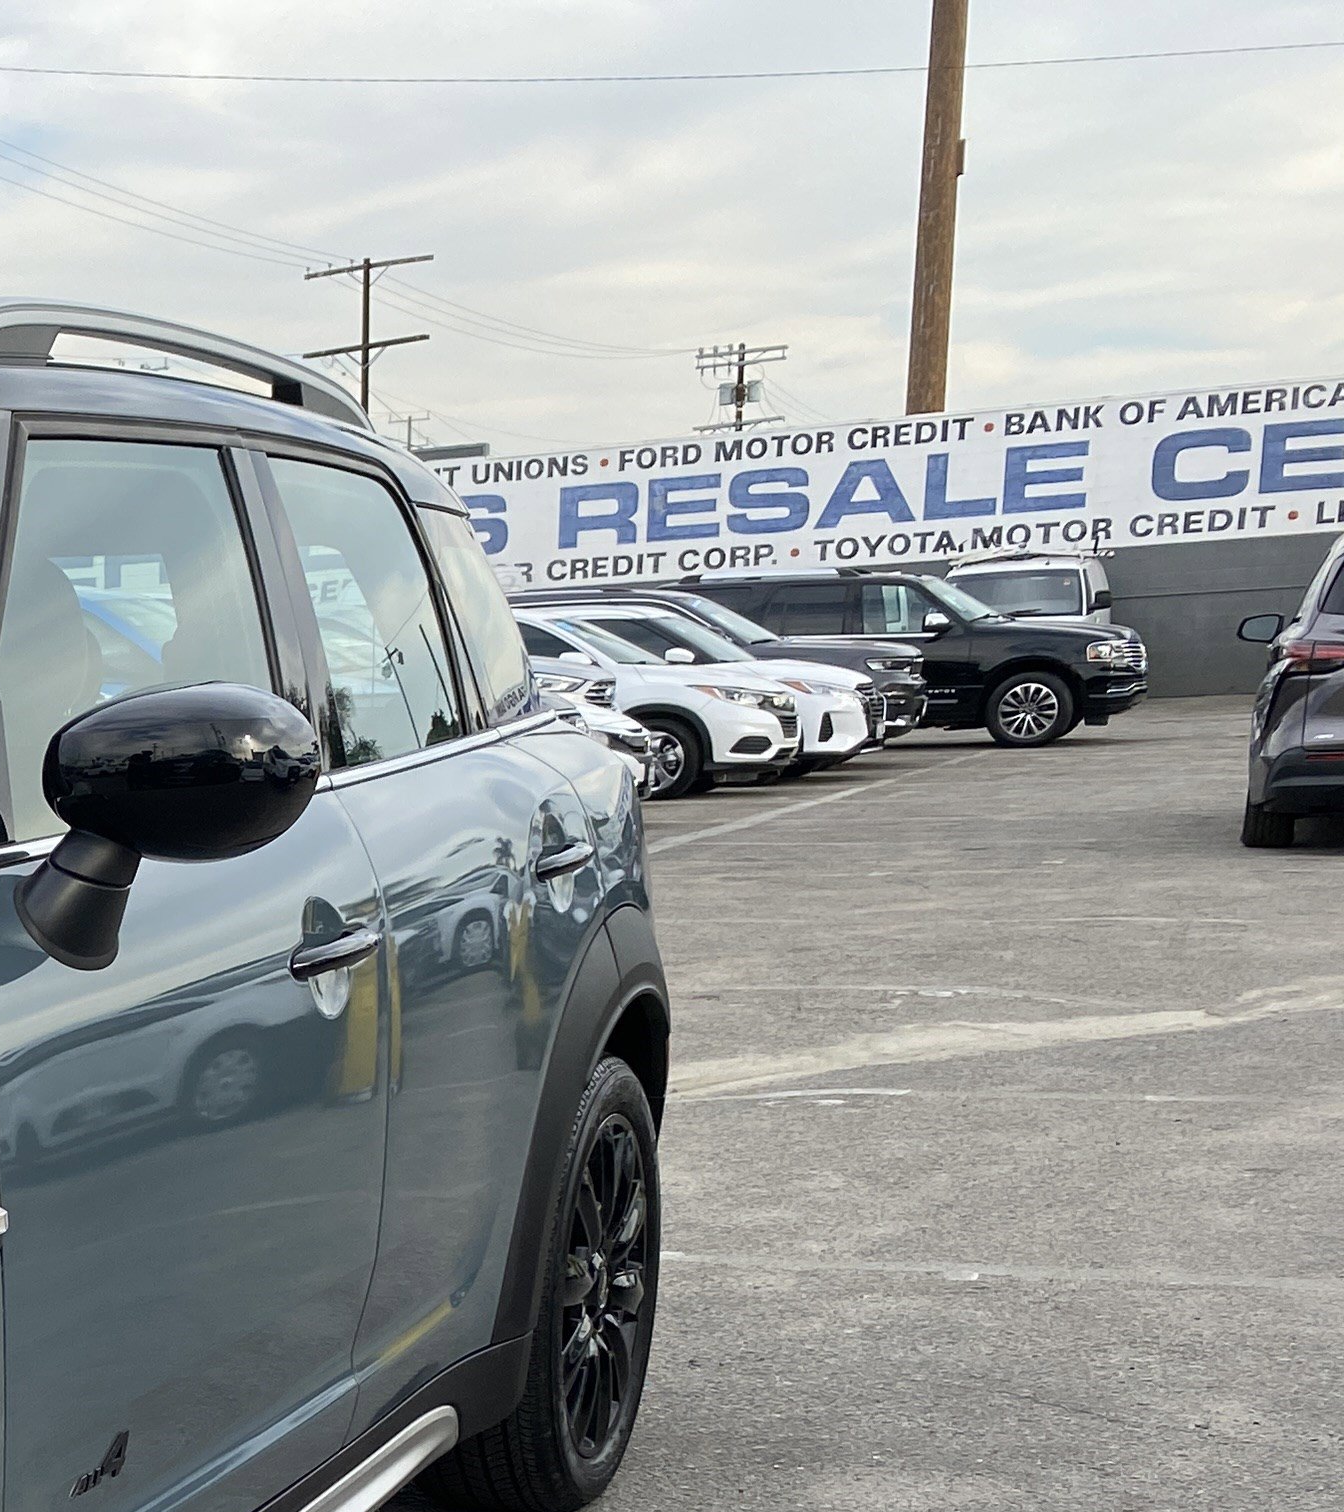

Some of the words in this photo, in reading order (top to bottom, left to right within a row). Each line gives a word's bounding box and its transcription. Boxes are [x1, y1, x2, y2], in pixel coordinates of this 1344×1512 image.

[472, 454, 588, 485] UNIONS
[618, 443, 702, 472] FORD
[714, 430, 834, 463] MOTOR
[847, 417, 974, 451] CREDIT
[1004, 404, 1104, 436] BANK
[1119, 398, 1166, 427] OF
[558, 439, 1090, 550] RESALE
[546, 551, 666, 582] CREDIT
[678, 543, 778, 571] CORP.
[814, 529, 957, 562] TOYOTA
[971, 517, 1113, 550] MOTOR
[1128, 505, 1276, 538] CREDIT
